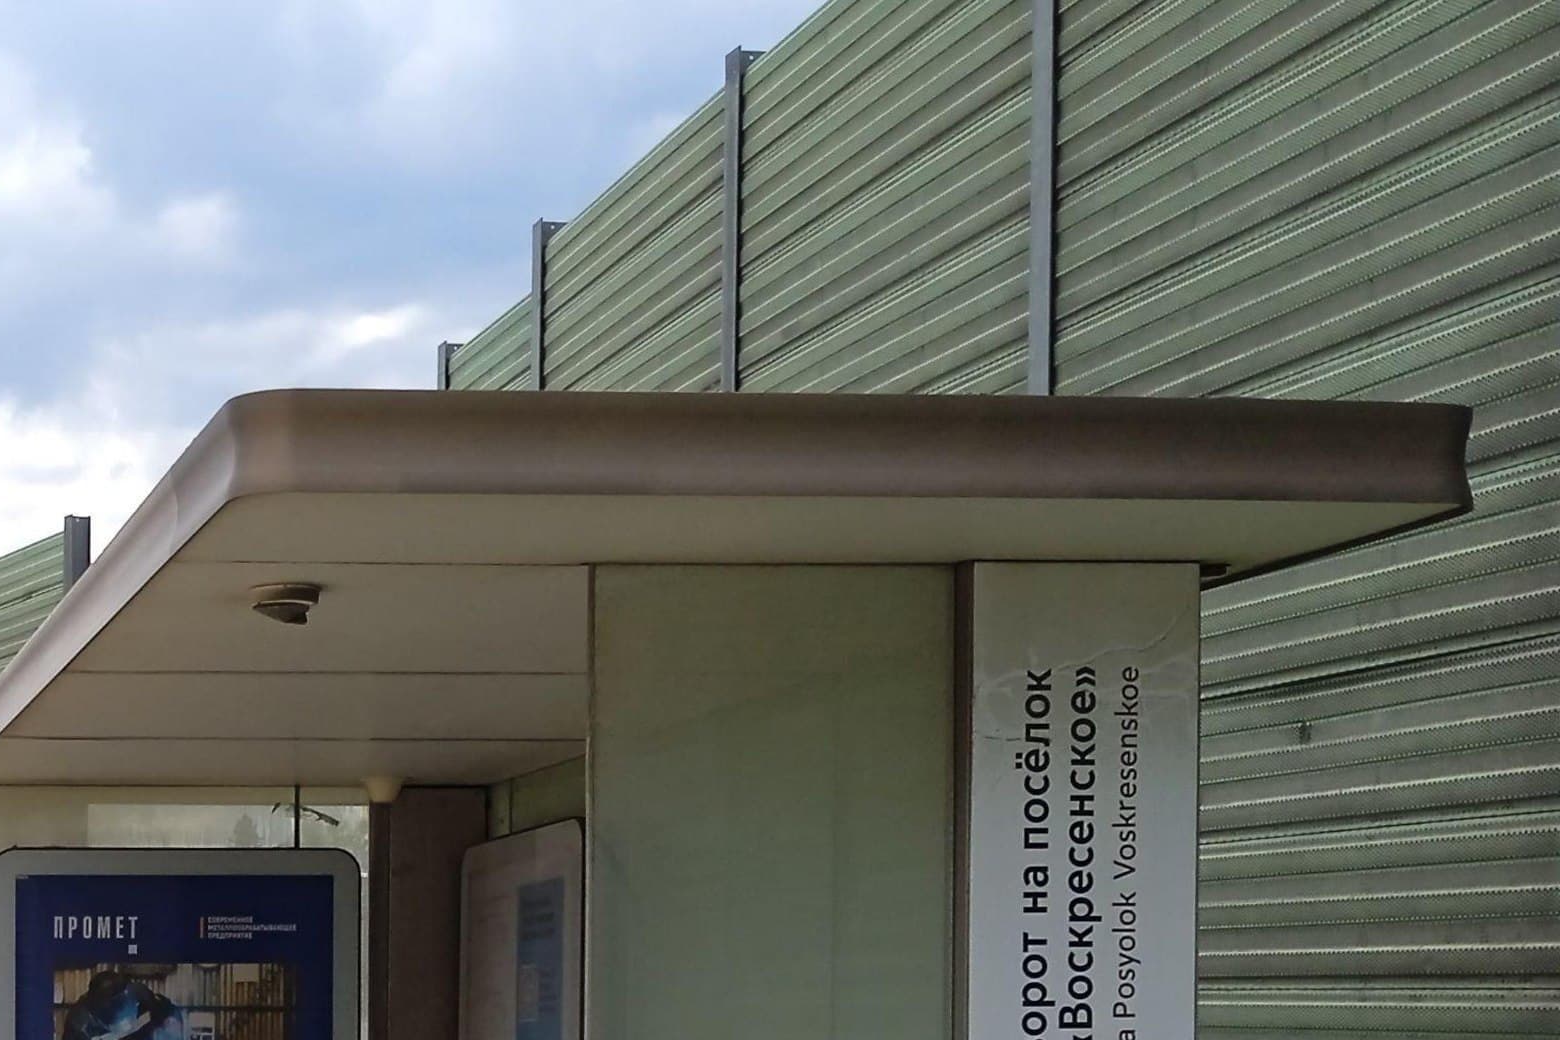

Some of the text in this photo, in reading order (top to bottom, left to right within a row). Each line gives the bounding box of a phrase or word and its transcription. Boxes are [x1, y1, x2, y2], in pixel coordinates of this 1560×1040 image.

[1015, 668, 1052, 849] посёлок
[1112, 666, 1139, 880] Voskresenskoe
[53, 915, 139, 939] ПРОМЕТ
[1023, 865, 1049, 913] на
[1111, 891, 1141, 1018] Posyolok
